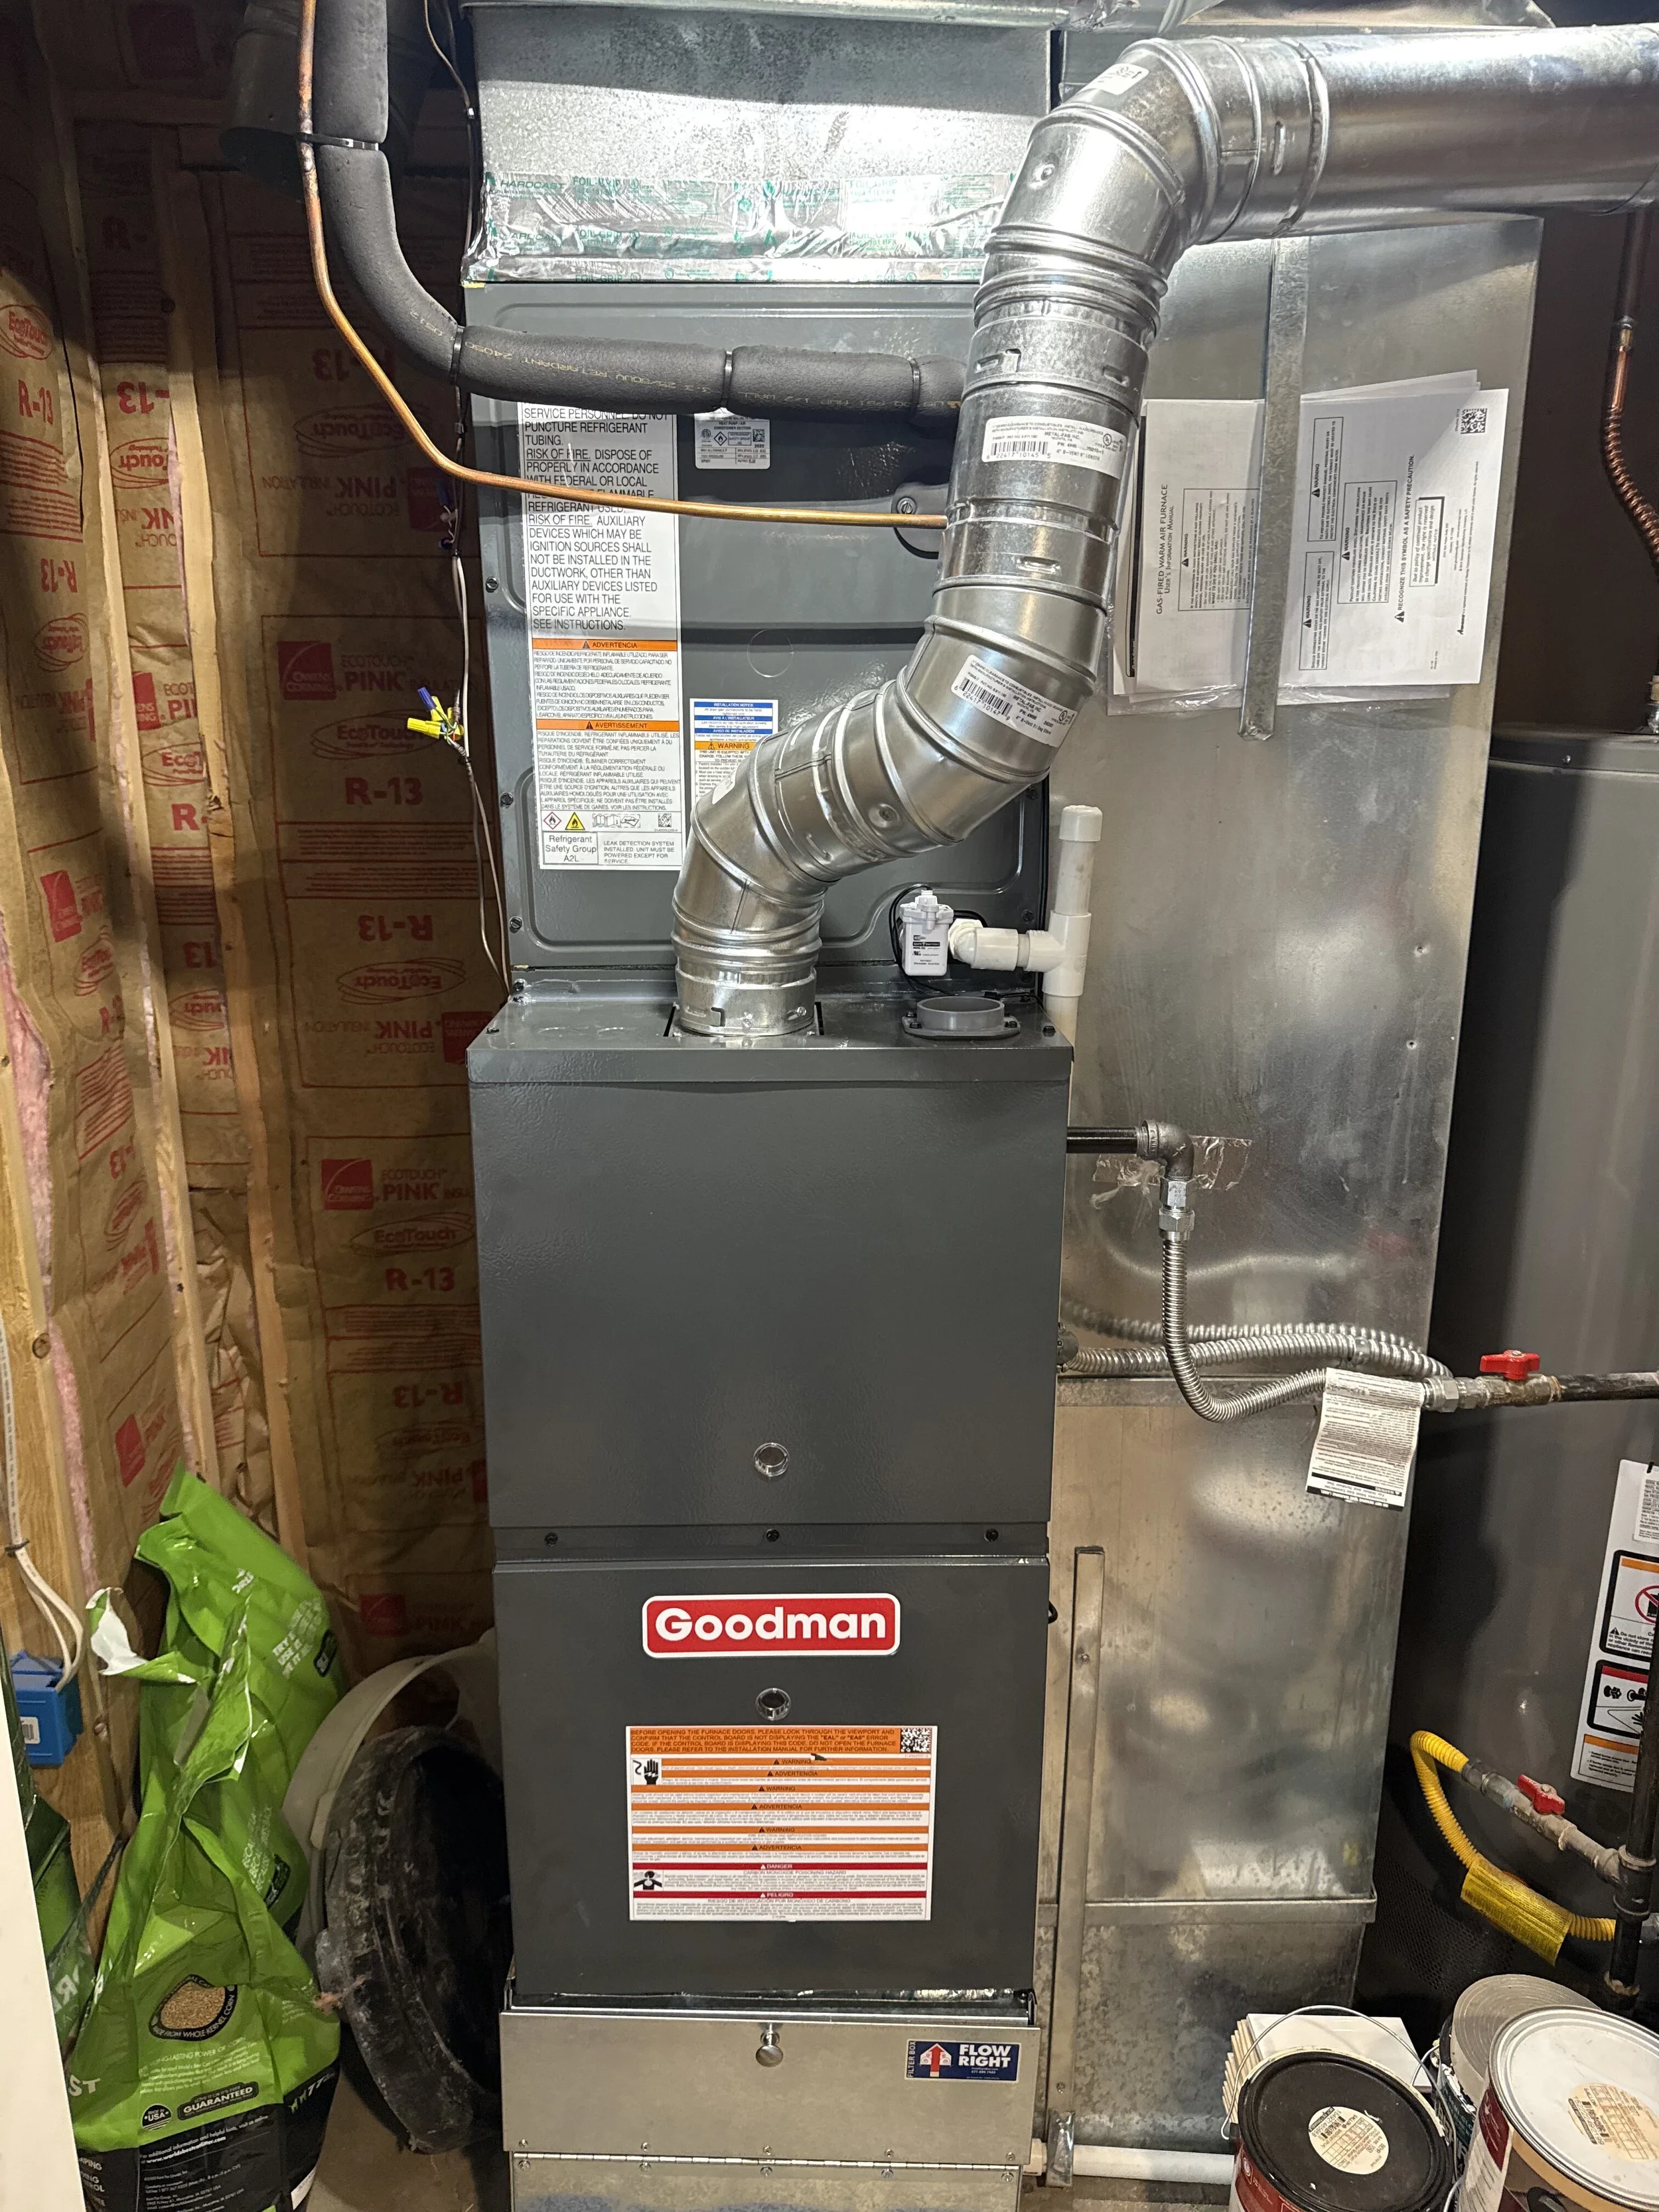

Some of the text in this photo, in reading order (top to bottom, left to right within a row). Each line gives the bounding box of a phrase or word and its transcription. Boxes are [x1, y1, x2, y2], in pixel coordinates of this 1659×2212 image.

[500, 180, 565, 190] HARDCAST
[19, 380, 53, 425] R-13
[524, 408, 565, 419] SERVICE
[525, 422, 647, 433] PUNCTURE REFRIGERANT
[527, 435, 563, 445] TUBING.
[526, 449, 652, 460] RISK OF FIRE. DISPOSE OF
[526, 462, 658, 473] PROPERLY IN ACCORDANCE
[555, 476, 597, 486] FEDERAL
[600, 476, 613, 486] OR
[617, 477, 648, 486] LOCAL
[336, 477, 397, 498] PINK
[1403, 526, 1409, 535] AS
[1406, 455, 1414, 495] PRECAUTION.
[528, 502, 594, 512] REFRIGERANT
[528, 514, 645, 526] RISK OF FIRE. AUXILIARY
[529, 528, 642, 539] DEVICES WHICH MAY BE
[530, 541, 652, 552] IGNITION SOURCES SHALL
[530, 554, 650, 565] NOT BE INSTALLED IN THE
[41, 558, 77, 593] R-13
[531, 567, 650, 579] DUCTWORK, OTHER THAN
[532, 580, 657, 591] AUXILIARY DEVICES LISTED
[1156, 570, 1165, 614] GAS-FIRED
[532, 593, 620, 604] FOR USE WITH THE
[532, 605, 631, 617] SPECIFIC APPLIANCE.
[533, 619, 627, 630] SEE INSTRUCTIONS.
[344, 672, 404, 692] PINK
[345, 777, 423, 805] R-13
[549, 834, 592, 844] Refrigerant
[545, 844, 597, 853] Safety Group
[358, 915, 433, 941] R-13
[354, 975, 442, 990] EcoTouch
[376, 1021, 433, 1039] PINK
[383, 1183, 439, 1201] PINK
[374, 1228, 459, 1244] EcoTouch
[385, 1267, 455, 1291] R-13
[392, 1381, 464, 1409] R-13
[655, 1606, 885, 1641] Goodman
[224, 1994, 235, 2016] CORN
[959, 2044, 1011, 2057] FLOW
[958, 2056, 1011, 2067] RIGHT
[183, 2087, 253, 2113] GUARANTEED
[148, 2112, 166, 2122] USA
